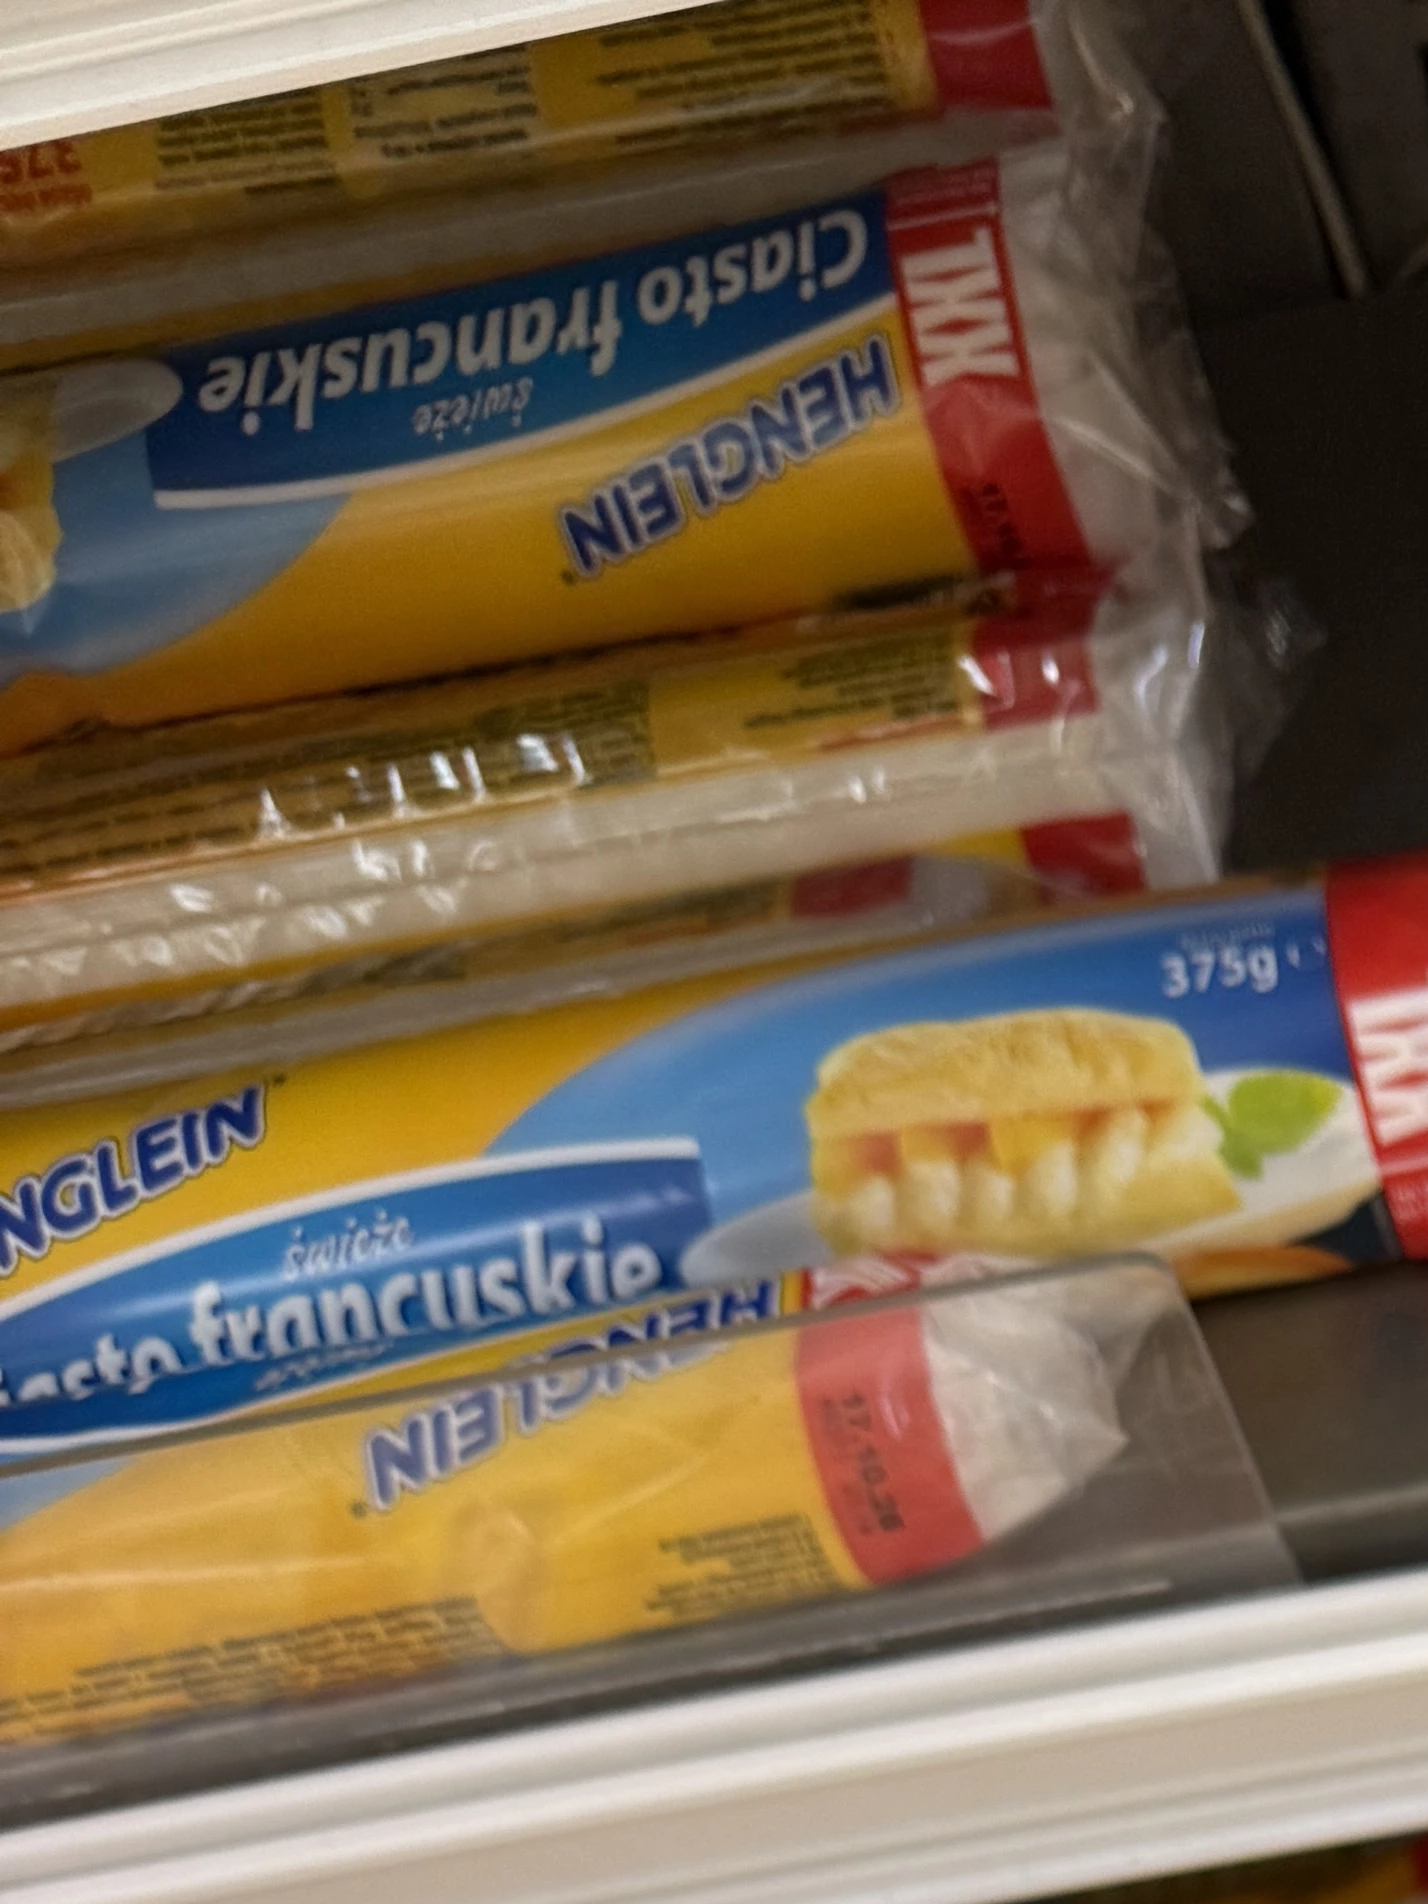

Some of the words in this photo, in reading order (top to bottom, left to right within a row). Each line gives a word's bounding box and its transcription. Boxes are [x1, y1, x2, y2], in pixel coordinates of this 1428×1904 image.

[638, 208, 869, 327] Ciasto
[900, 226, 1018, 387] XXL
[199, 279, 623, 435] francuskie
[562, 335, 901, 574] HENGLEIN
[191, 1217, 662, 1370] francuskie
